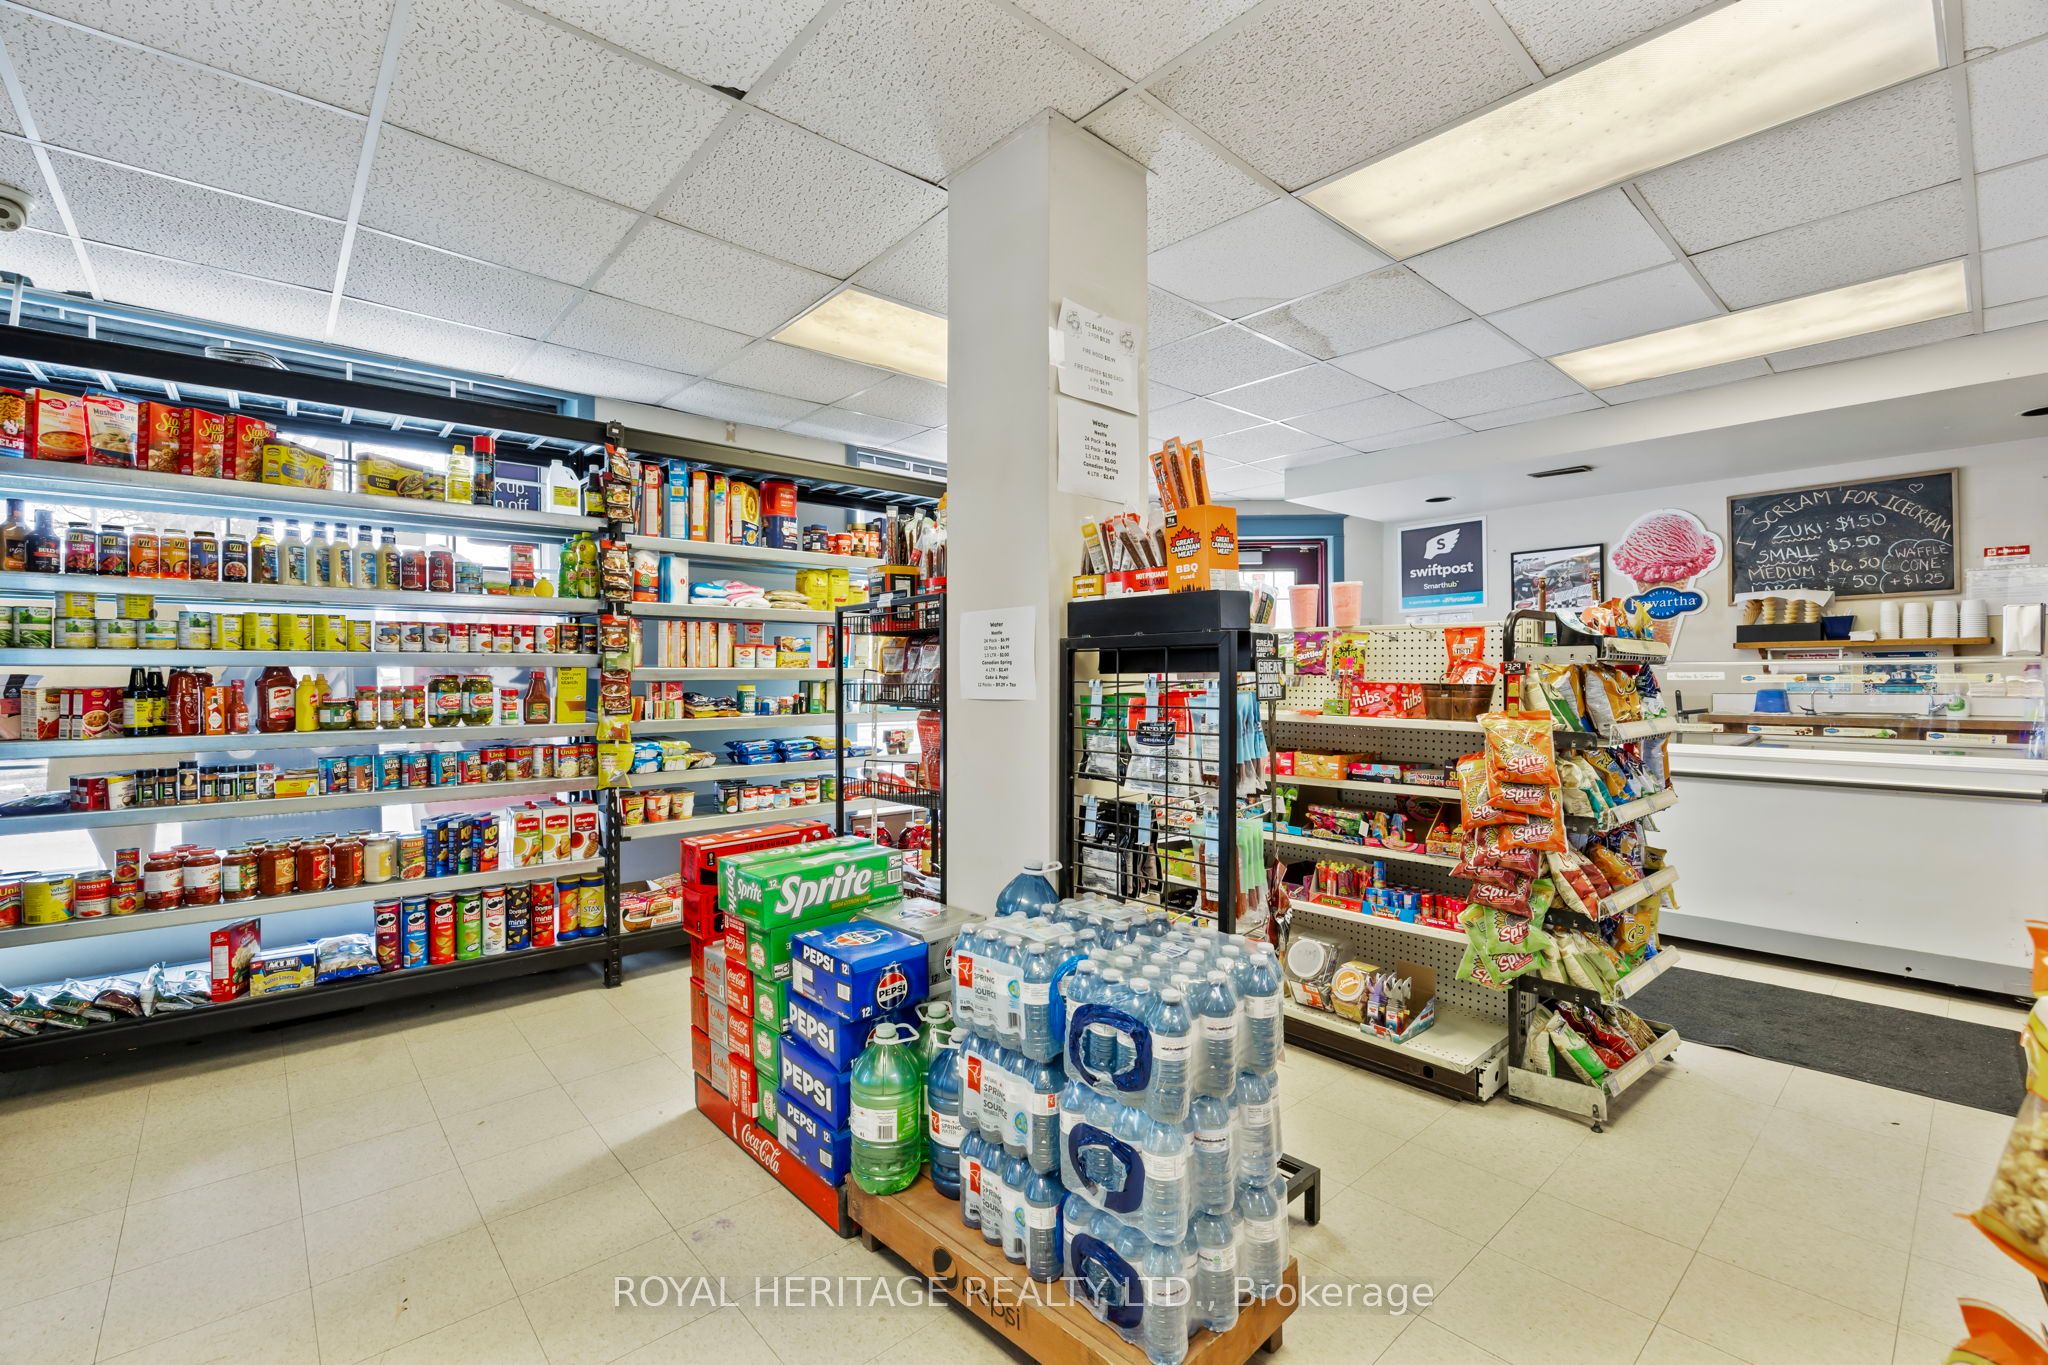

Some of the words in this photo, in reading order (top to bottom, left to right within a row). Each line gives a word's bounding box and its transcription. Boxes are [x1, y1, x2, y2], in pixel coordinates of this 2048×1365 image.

[1092, 419, 1109, 429] Water
[242, 423, 270, 442] Stove
[1104, 465, 1119, 475] Spring
[506, 482, 528, 497] up.
[1752, 491, 1831, 533] SCREAM
[1841, 489, 1879, 505] FOR
[1834, 512, 1887, 532] $4.50
[139, 539, 150, 547] VH
[174, 540, 185, 548] VH
[1171, 543, 1201, 553] CANADIAN
[1175, 537, 1194, 546] GREAT
[1827, 535, 1880, 553] $5.50
[1177, 550, 1194, 558] MEAT
[1895, 544, 1949, 558] WAFFLE
[1175, 562, 1199, 574] BBQ
[1409, 561, 1474, 578] swiftpost
[1828, 557, 1880, 575] $6.50
[1139, 578, 1165, 588] SALAMI
[1423, 581, 1458, 590] Smarthub
[1903, 572, 1945, 587] $1.25
[1296, 649, 1323, 661] Skittles
[1258, 661, 1282, 673] GREAT
[1259, 684, 1281, 698] MEAT
[1354, 689, 1381, 707] nibs
[1403, 689, 1422, 711] nibs
[1507, 753, 1544, 771] Spitz
[1504, 785, 1541, 800] Spitz
[461, 825, 472, 840] KD
[484, 825, 498, 840] KD
[1513, 823, 1550, 842] Spitz
[402, 839, 424, 848] PRIMO
[737, 878, 763, 903] Sprite
[775, 863, 872, 919] Sprite
[486, 908, 504, 917] PRINGLES
[583, 905, 600, 913] STAX
[434, 916, 453, 925] PRINGLES
[463, 914, 481, 923] PRINGLES
[508, 918, 527, 927] minis
[534, 914, 553, 922] minis
[407, 923, 426, 933] PRINGLES
[803, 944, 835, 973] PEPSI
[841, 962, 848, 975] 12
[878, 984, 906, 999] PEPSI
[861, 1007, 870, 1019] 12
[788, 1001, 835, 1053] PEPSI
[782, 1055, 833, 1113] PEPSI
[983, 1084, 1007, 1102] SPRING
[983, 1099, 1008, 1120] SOURCE
[787, 1102, 817, 1138] PEPSI
[942, 1123, 962, 1131] SPRING
[741, 1123, 780, 1174] Coca-Cola
